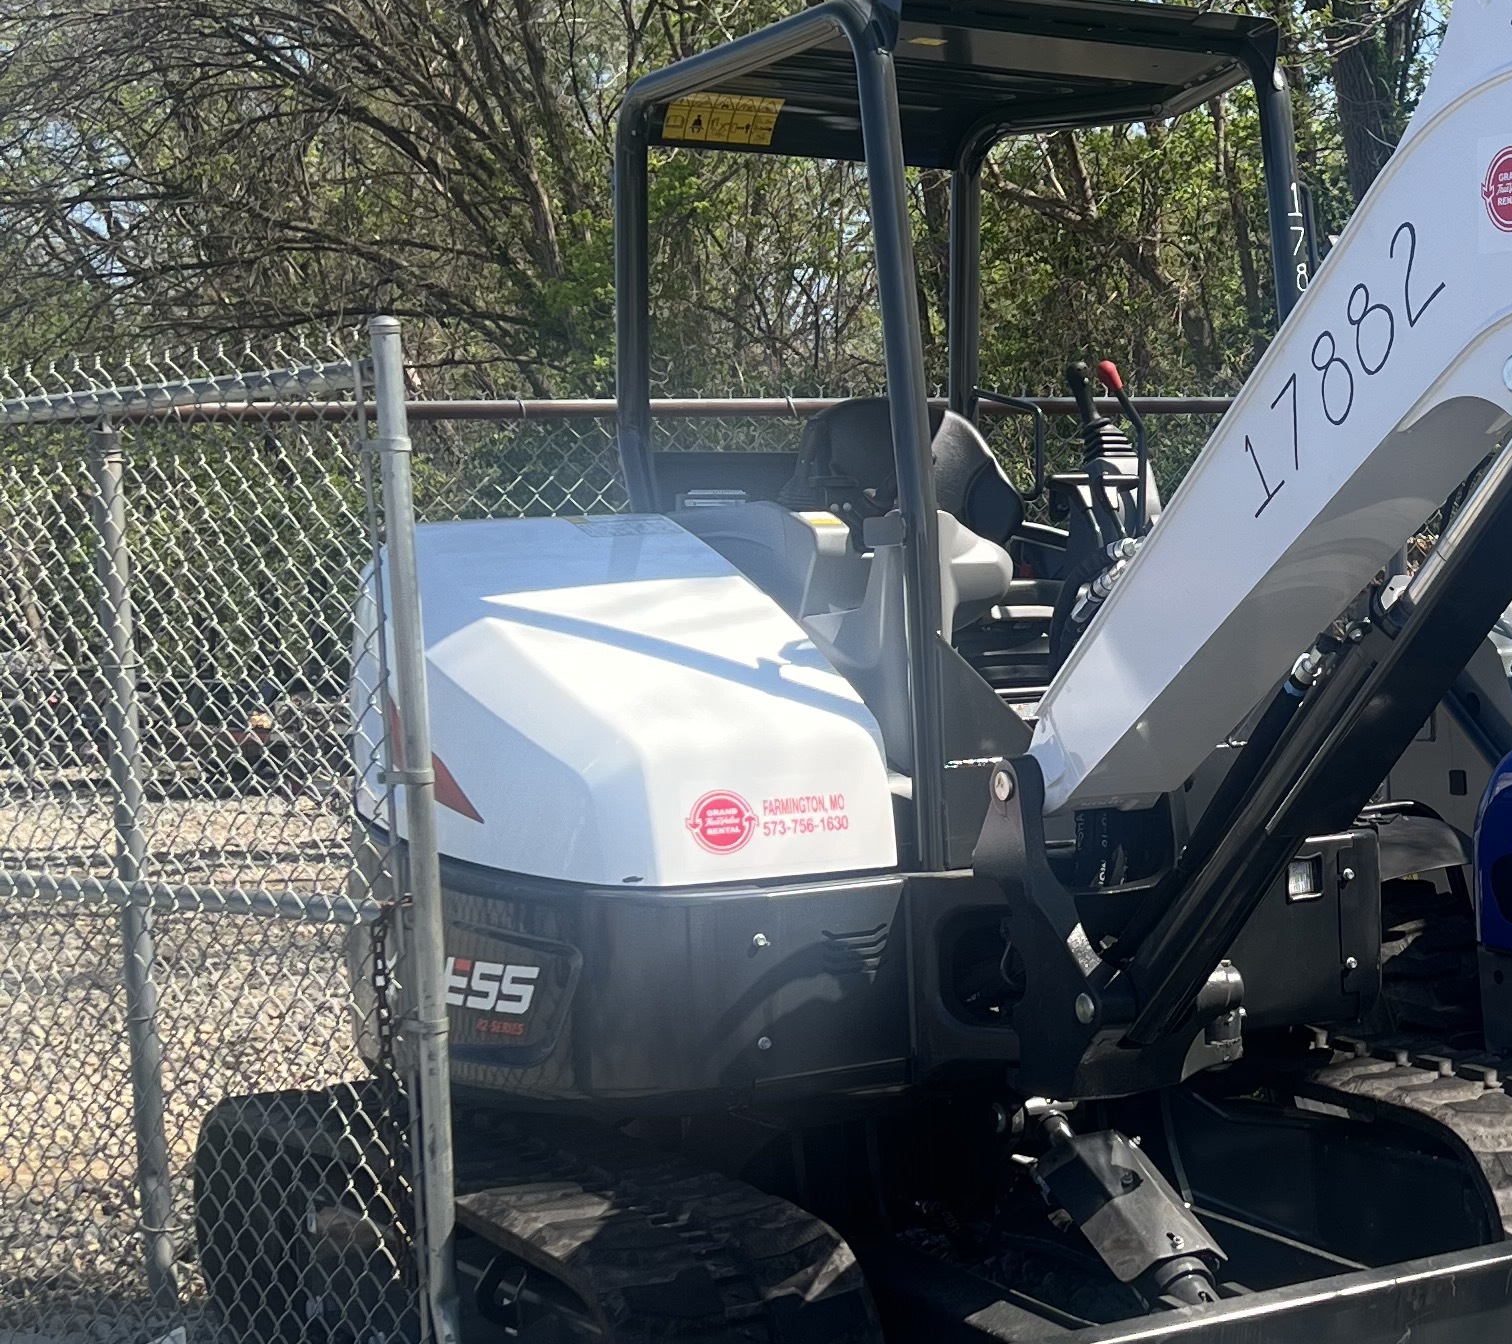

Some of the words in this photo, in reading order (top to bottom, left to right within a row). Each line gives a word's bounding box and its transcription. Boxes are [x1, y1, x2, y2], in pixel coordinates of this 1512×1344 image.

[1244, 221, 1447, 519] 17882
[762, 795, 829, 817] FARMINGTON,
[829, 793, 845, 811] MO
[763, 815, 849, 837] 573-756-1630
